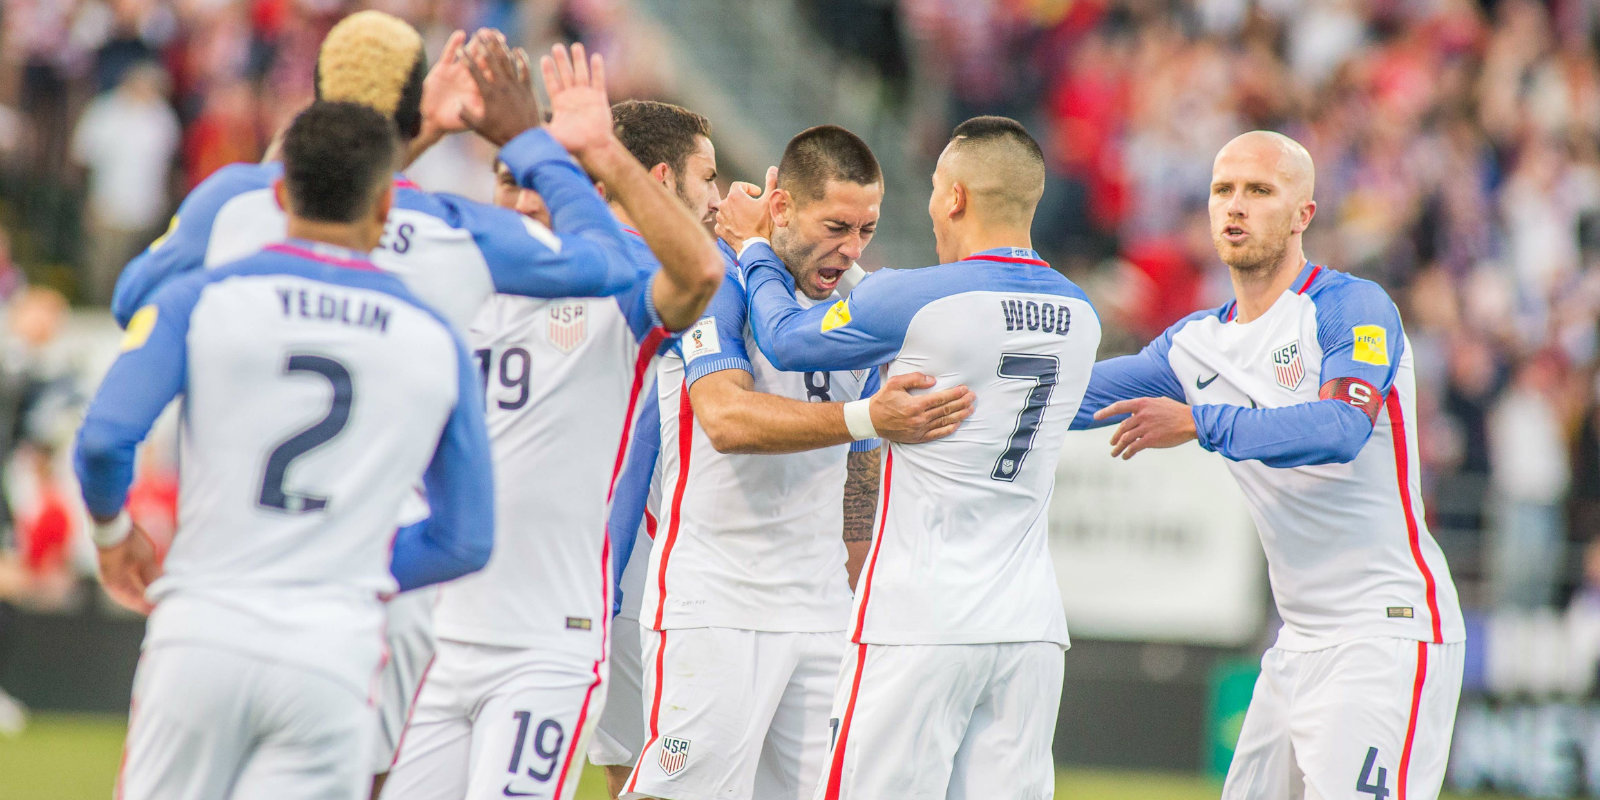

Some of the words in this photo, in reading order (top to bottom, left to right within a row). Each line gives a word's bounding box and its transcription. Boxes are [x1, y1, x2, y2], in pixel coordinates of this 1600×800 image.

[1015, 249, 1029, 257] USA
[275, 286, 391, 333] YEDLIN
[550, 304, 583, 324] USA
[1000, 299, 1071, 336] WOOD
[1273, 343, 1298, 365] USA
[1357, 335, 1376, 345] FIFA
[474, 347, 531, 411] 19
[803, 371, 831, 403] 8
[259, 353, 353, 511] 2
[990, 352, 1060, 482] 7
[508, 710, 564, 782] 19
[663, 737, 688, 754] USA
[1356, 746, 1390, 800] 4
